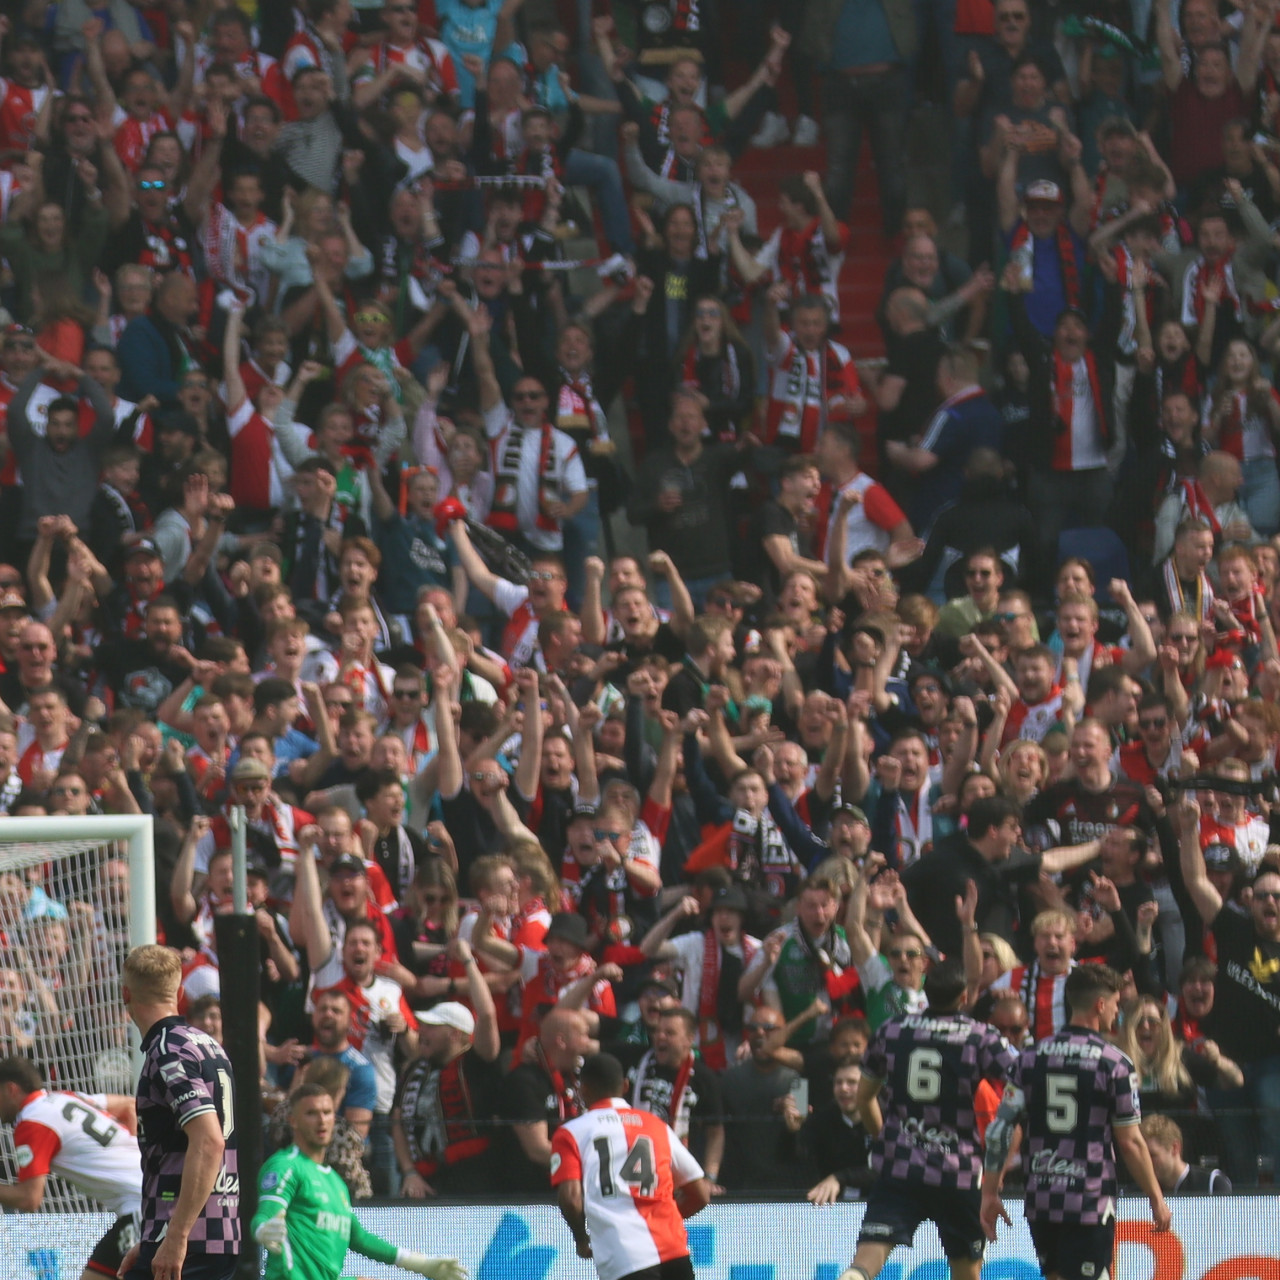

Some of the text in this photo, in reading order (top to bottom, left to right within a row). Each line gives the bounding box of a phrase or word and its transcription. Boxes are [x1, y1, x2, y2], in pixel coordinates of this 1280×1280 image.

[900, 1016, 972, 1036] JUMPER
[1037, 1040, 1103, 1060] JUMPER
[907, 1048, 943, 1101] 6
[170, 1089, 207, 1110] TAMOIL
[1045, 1073, 1079, 1134] 5
[62, 1101, 118, 1147] 2
[593, 1135, 658, 1199] 14
